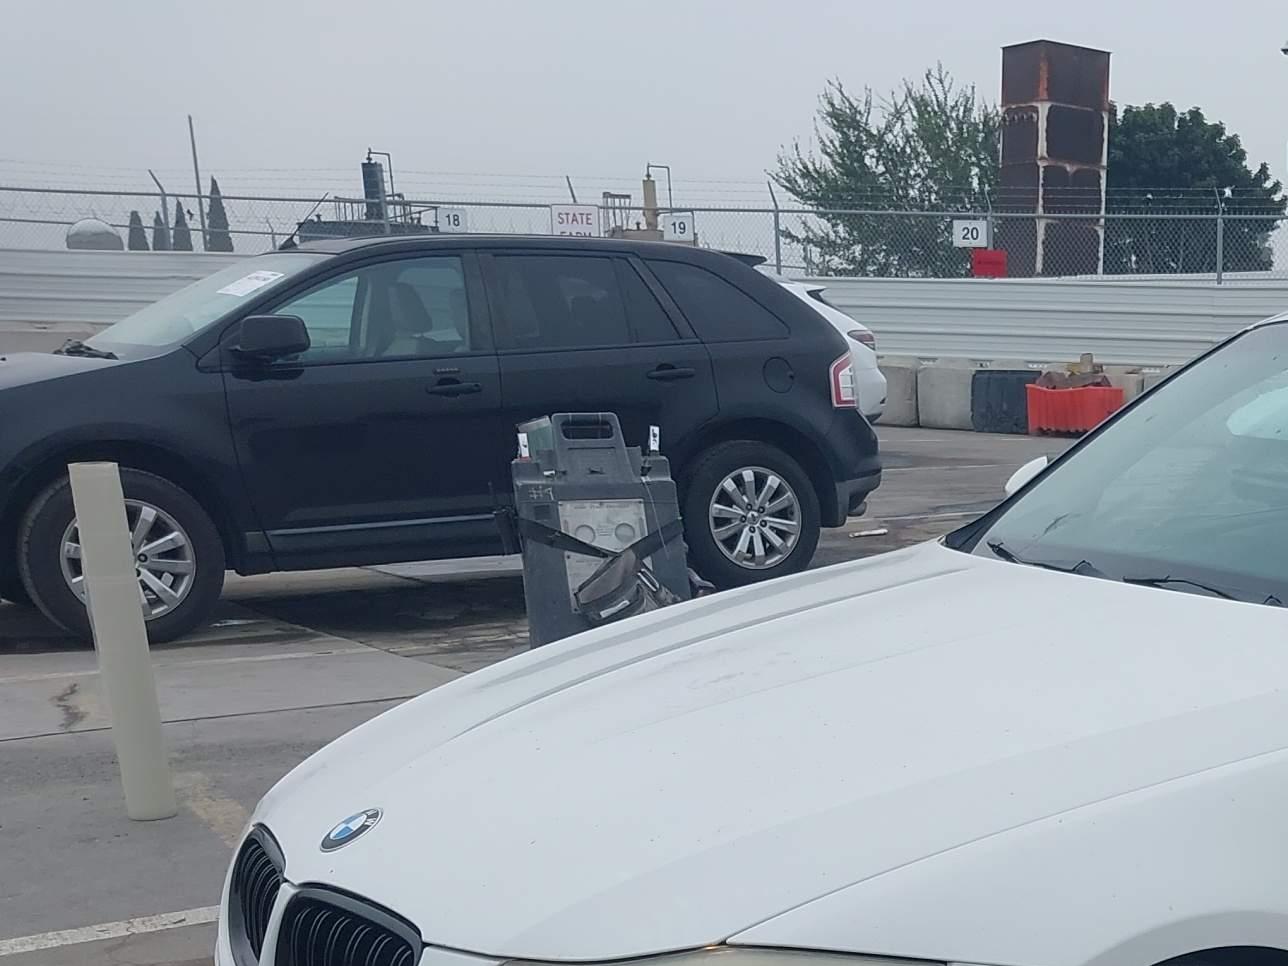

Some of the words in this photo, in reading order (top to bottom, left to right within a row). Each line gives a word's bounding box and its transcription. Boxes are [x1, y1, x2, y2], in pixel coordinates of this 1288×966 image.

[445, 213, 460, 227] 18
[557, 212, 592, 225] STATE
[671, 221, 686, 235] 19
[961, 226, 979, 240] 20
